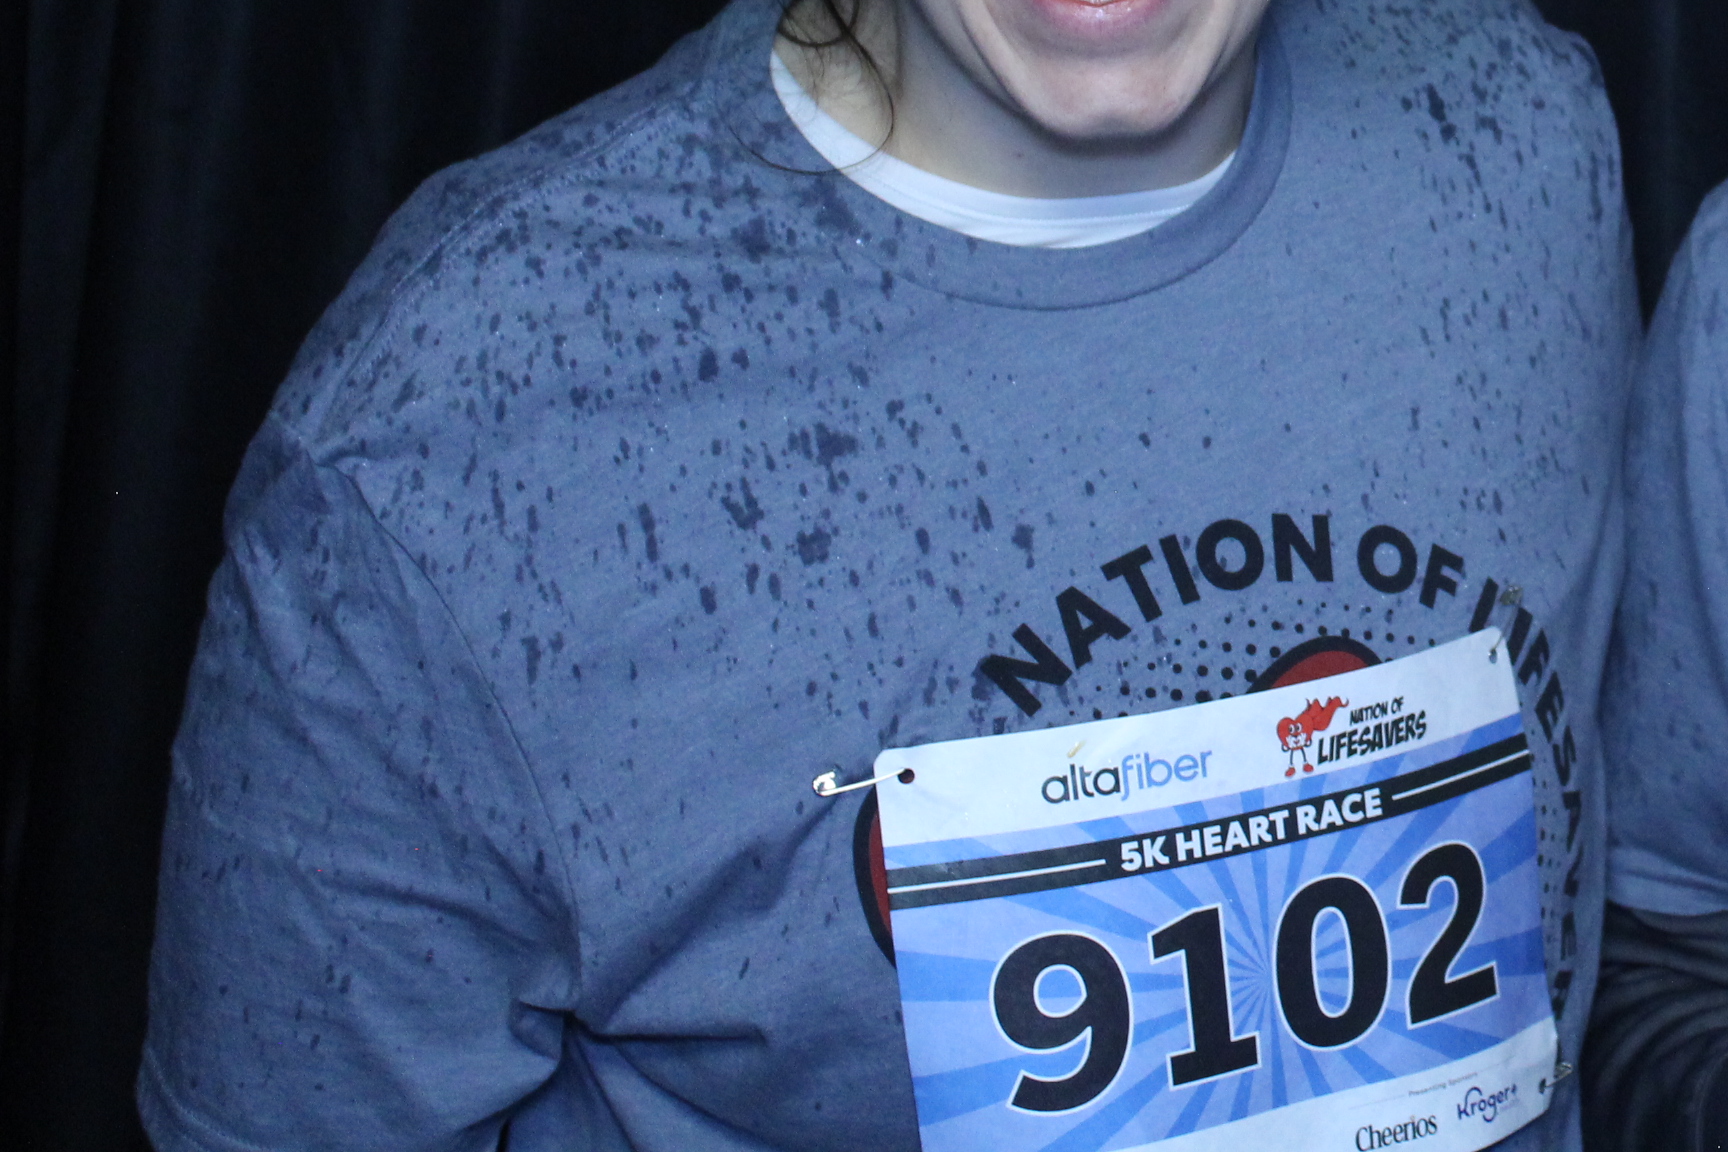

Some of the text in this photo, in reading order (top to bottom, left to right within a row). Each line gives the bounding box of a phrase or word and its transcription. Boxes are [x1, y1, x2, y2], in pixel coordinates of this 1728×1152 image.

[981, 512, 1333, 717] NATION
[1356, 523, 1464, 609] OF
[1318, 711, 1427, 765] LIFESAVERS
[1349, 697, 1404, 727] NATION OF
[1041, 750, 1212, 804] altafiber
[1120, 788, 1384, 872] 5K HEART RACE
[988, 840, 1500, 1115] 9102
[1355, 1114, 1438, 1152] Cheerios
